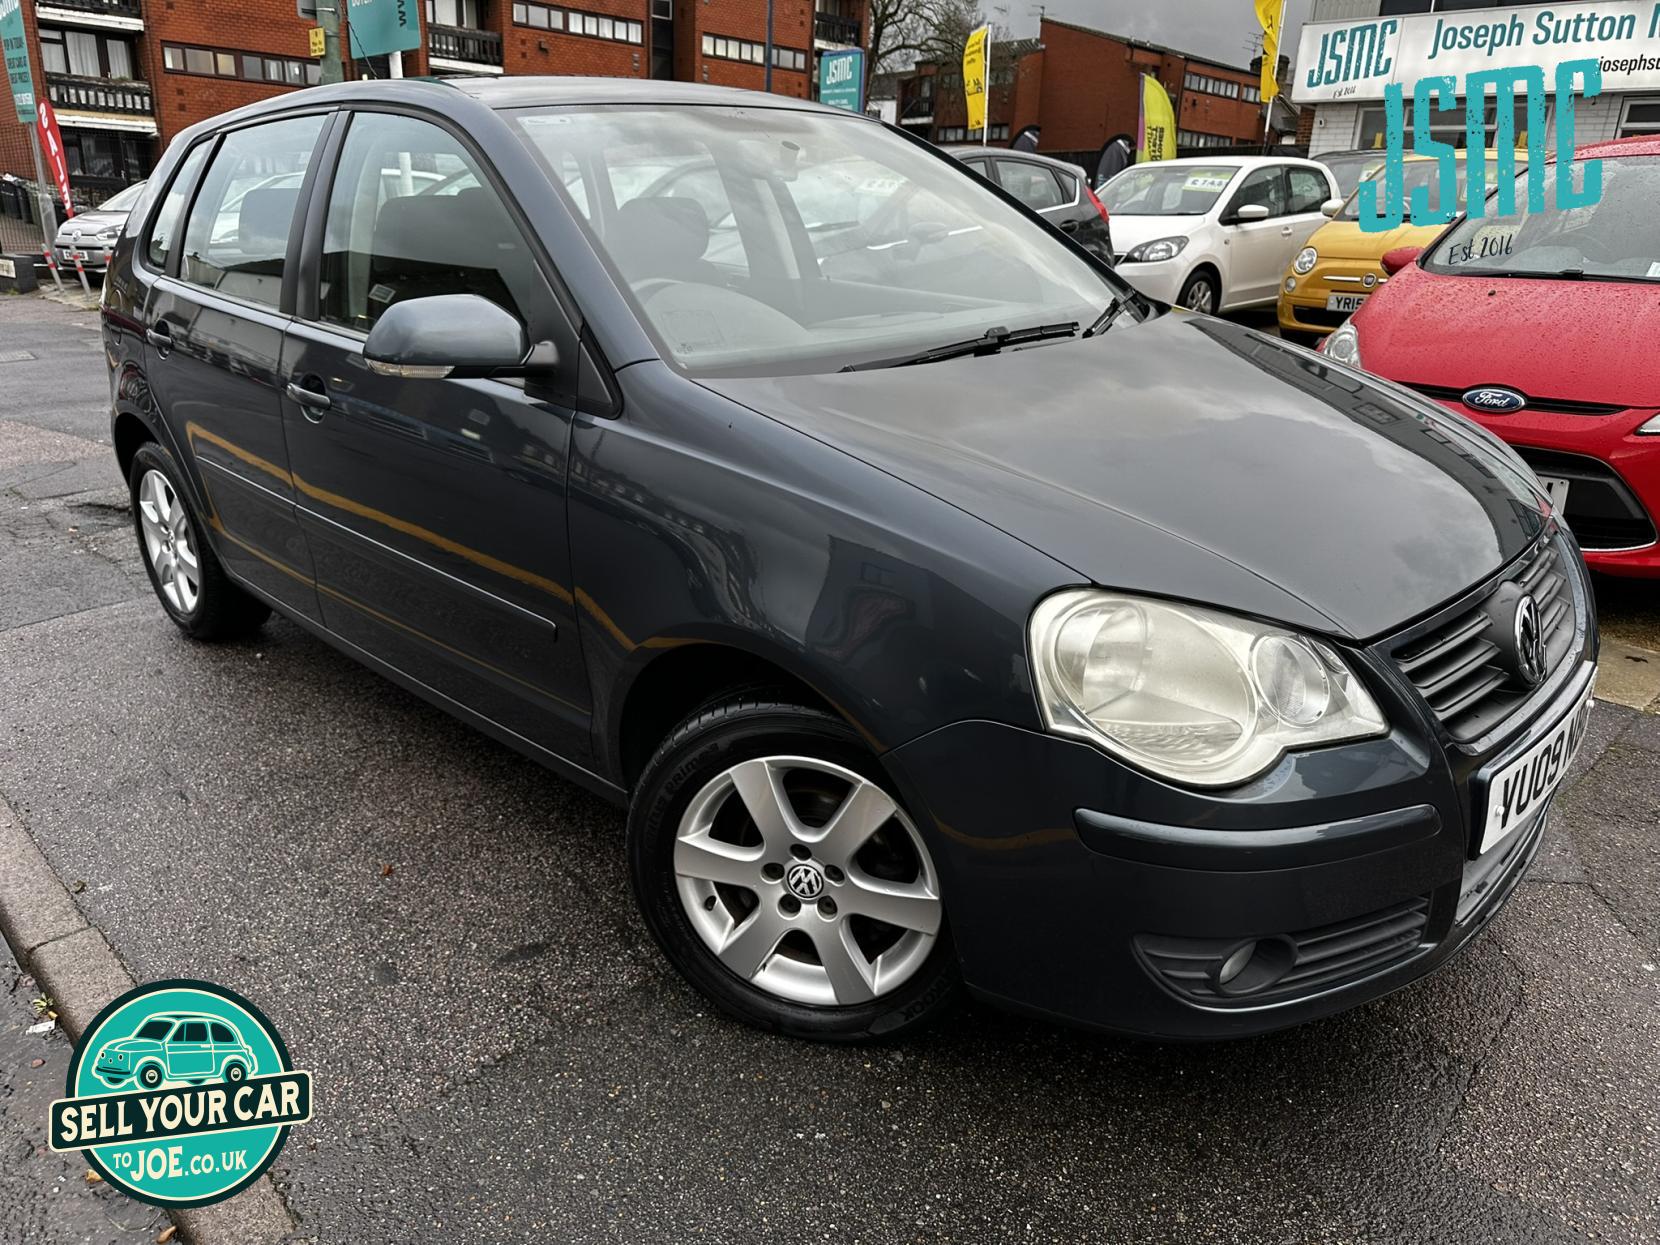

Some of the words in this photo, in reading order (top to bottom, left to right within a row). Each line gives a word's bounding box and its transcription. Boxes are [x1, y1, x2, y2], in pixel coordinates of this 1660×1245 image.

[1307, 19, 1398, 88] JSMC
[1428, 14, 1525, 60] Joseph
[1532, 10, 1637, 45] Sutton
[826, 55, 853, 85] JSMC
[1474, 391, 1511, 407] Ford
[1499, 730, 1566, 830] VU09
